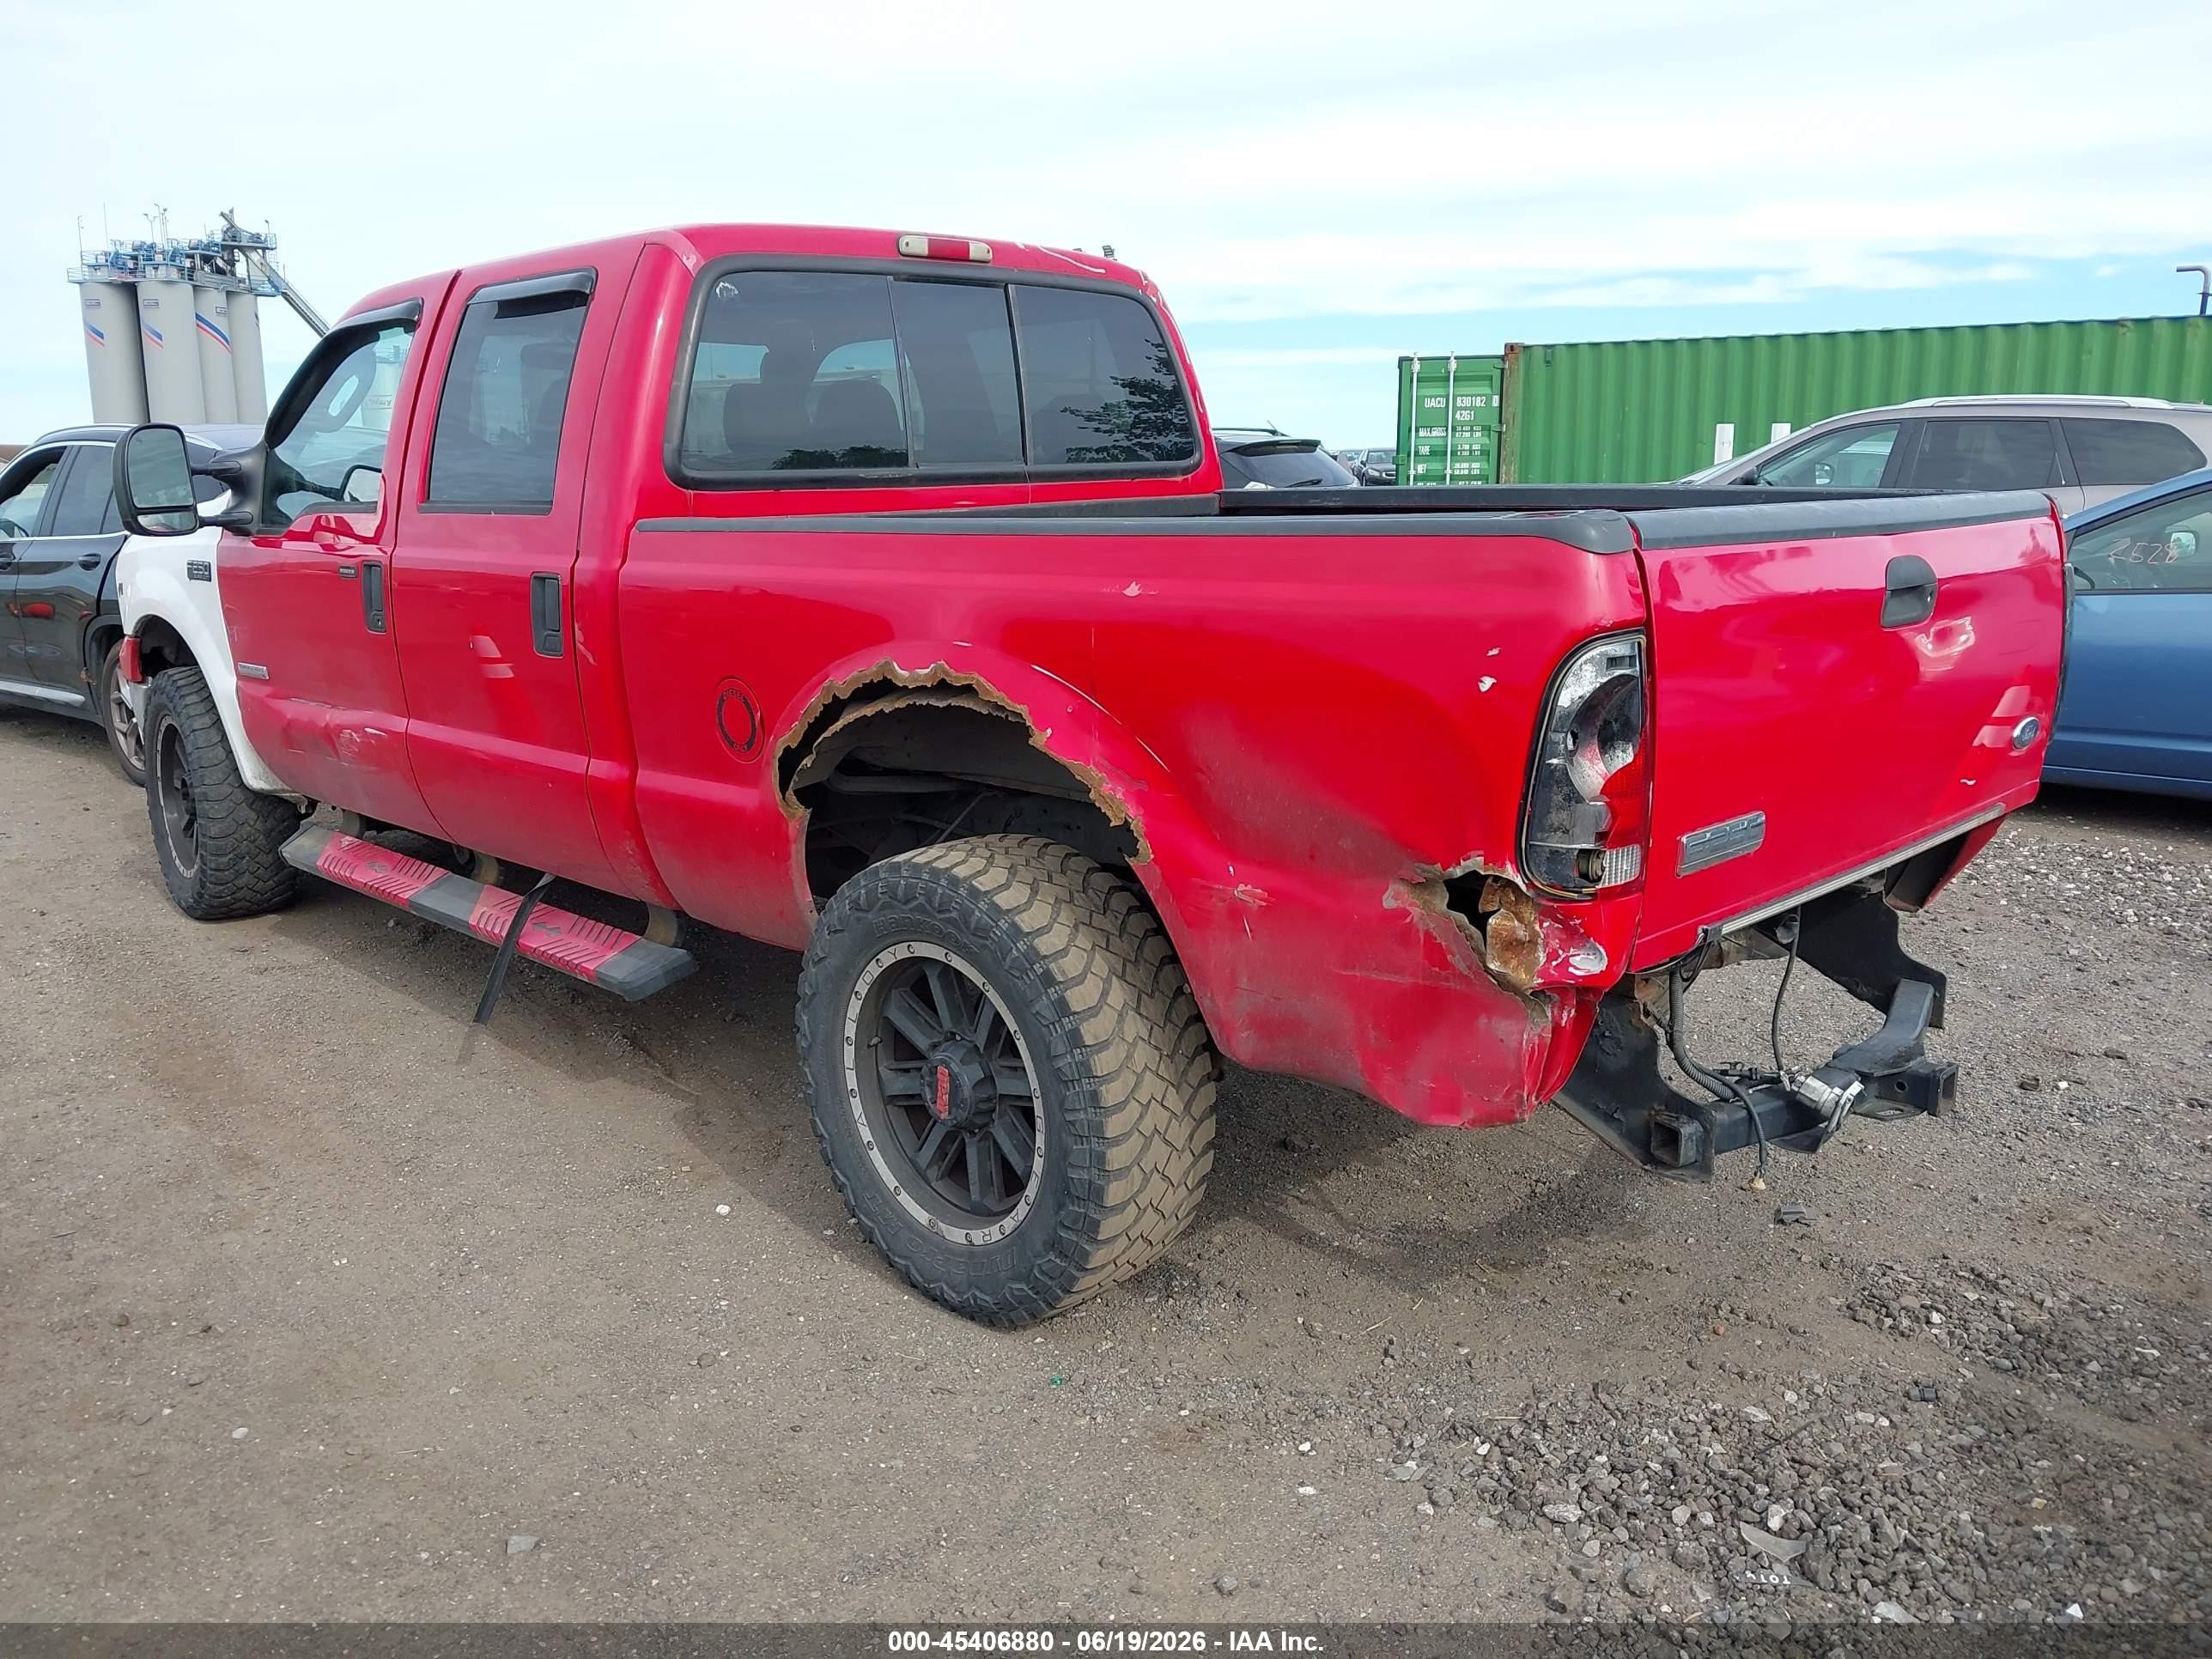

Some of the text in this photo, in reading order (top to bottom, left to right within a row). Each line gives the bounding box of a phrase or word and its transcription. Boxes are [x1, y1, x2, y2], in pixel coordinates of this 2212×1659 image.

[1425, 398, 1446, 408] UACU
[1456, 396, 1486, 407] 830182
[1455, 410, 1474, 421] 42G1
